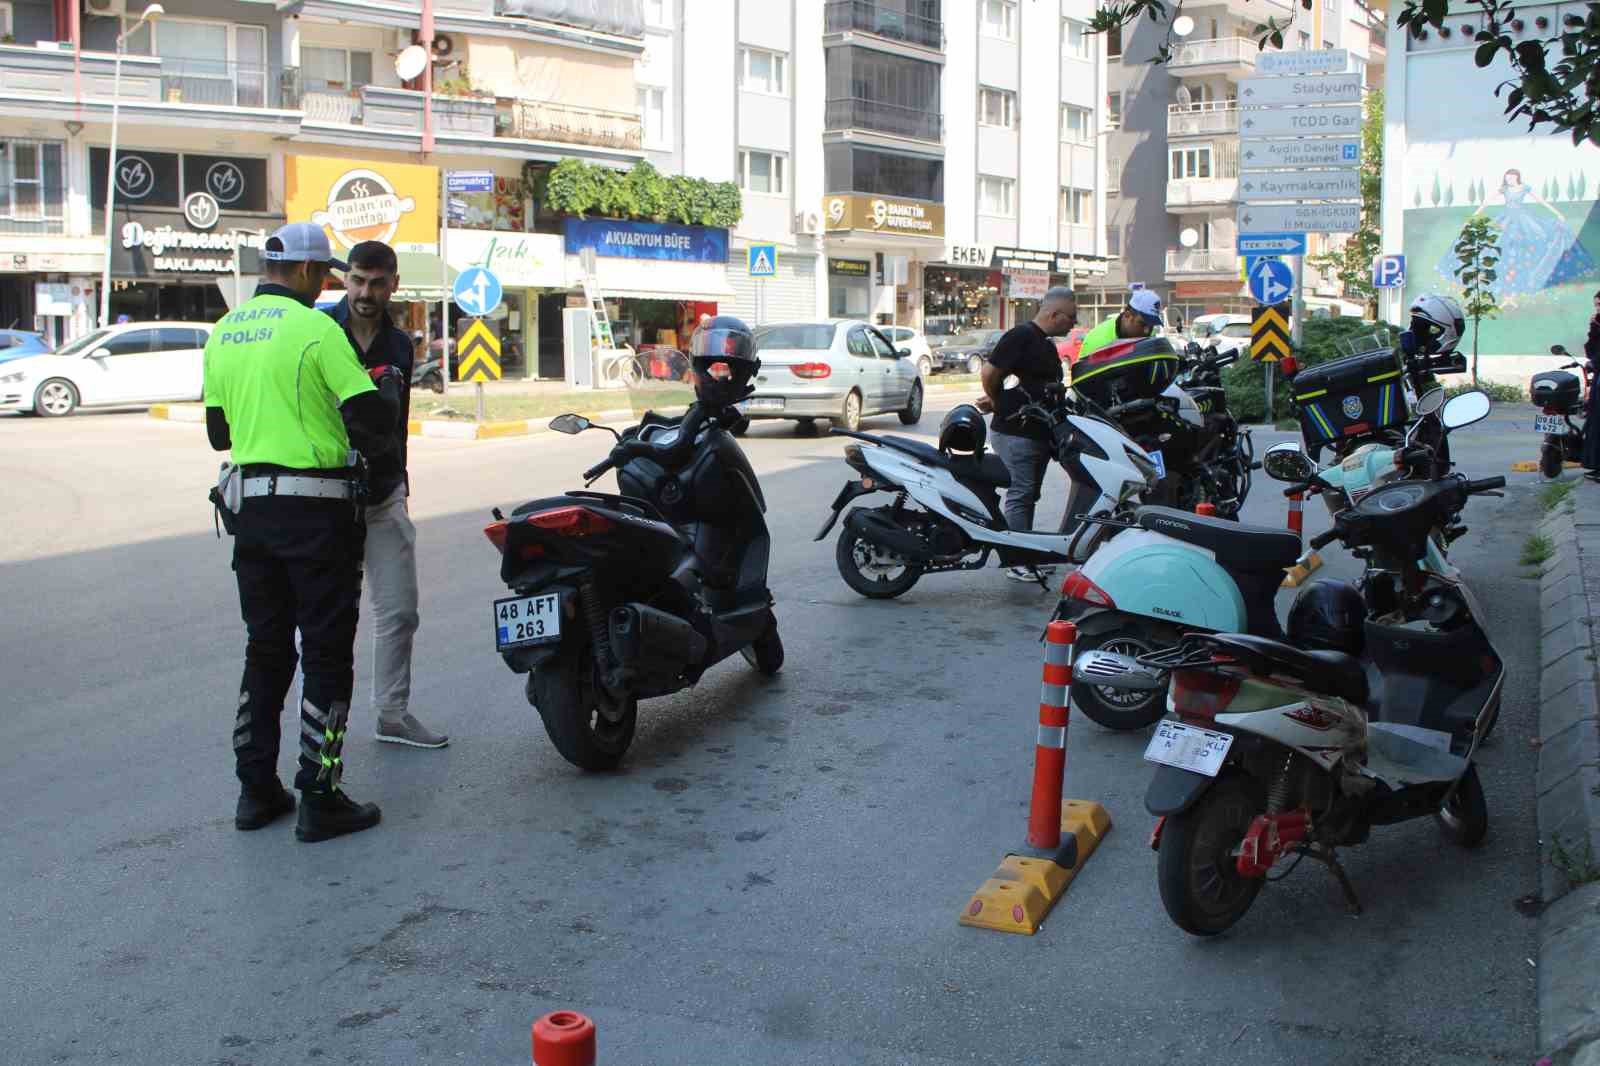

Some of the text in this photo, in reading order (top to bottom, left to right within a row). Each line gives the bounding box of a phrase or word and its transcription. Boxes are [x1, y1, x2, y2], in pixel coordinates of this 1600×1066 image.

[1293, 82, 1357, 96] Stadyum
[1290, 115, 1355, 127] TCDD Gar
[605, 230, 691, 249] AKVARYUM BÜFE
[952, 246, 987, 263] EKEN
[1381, 257, 1401, 285] P
[499, 597, 555, 621] 48 AFT
[516, 619, 545, 639] 263
